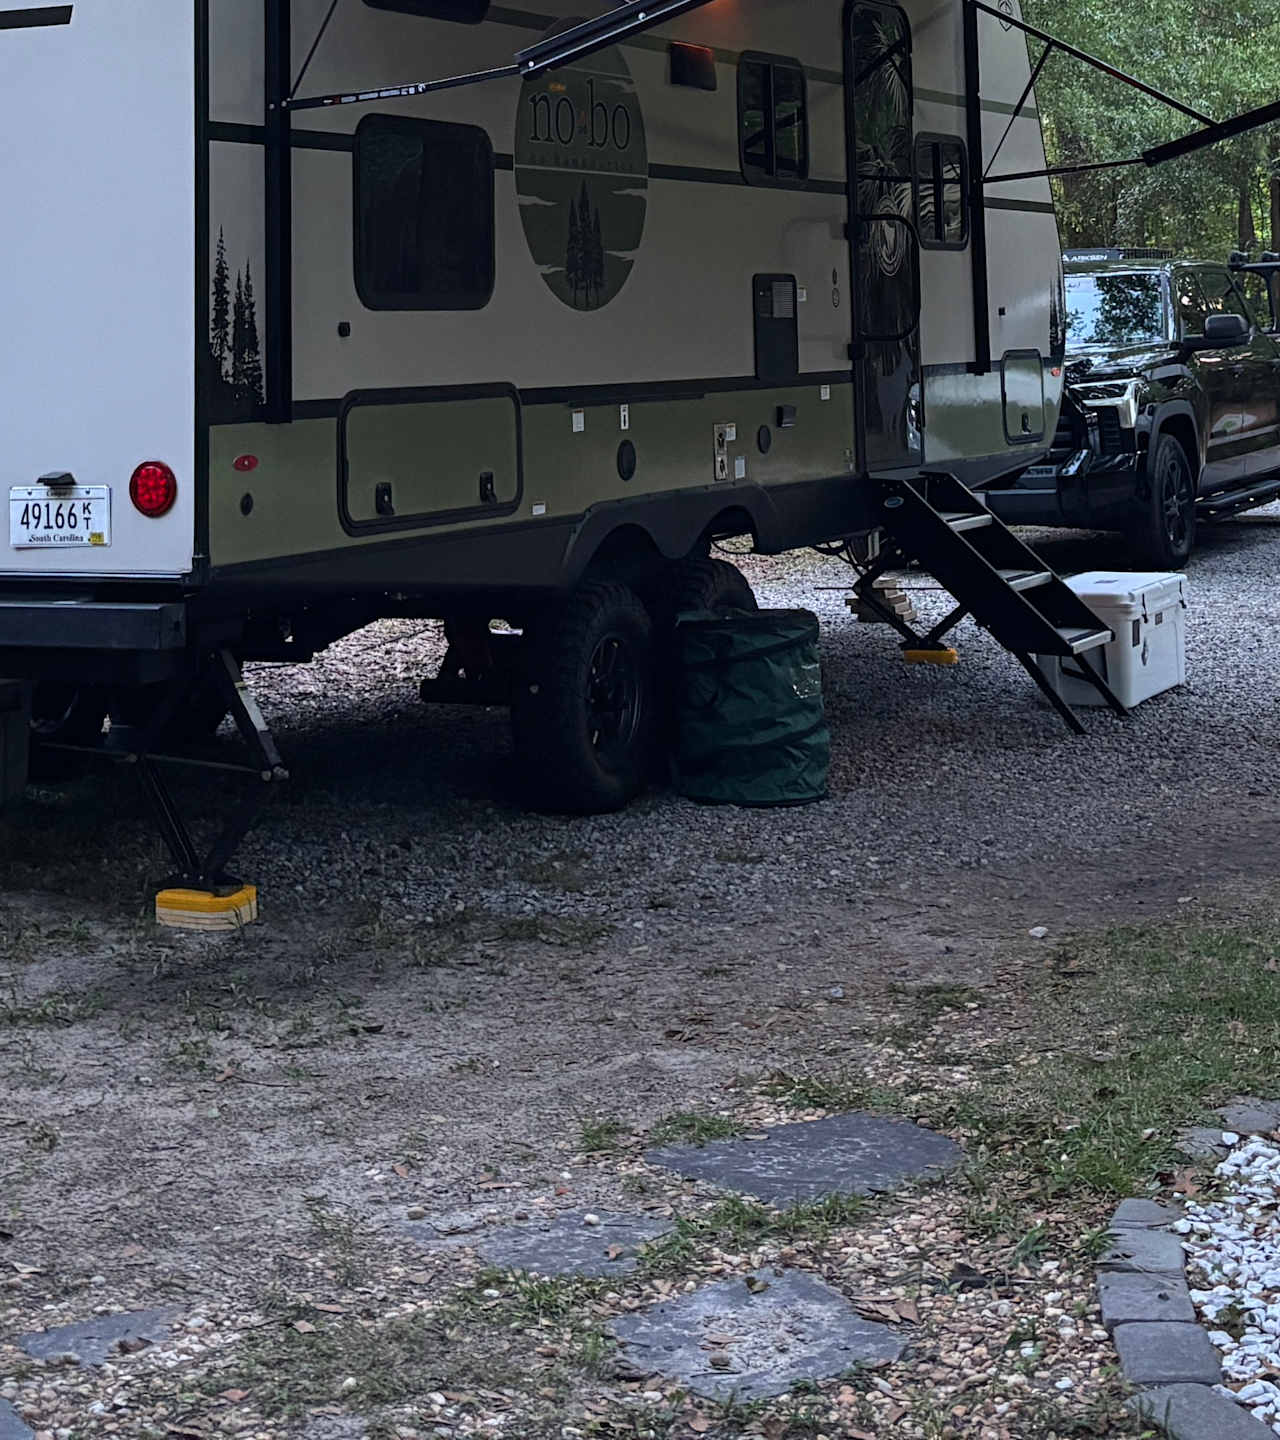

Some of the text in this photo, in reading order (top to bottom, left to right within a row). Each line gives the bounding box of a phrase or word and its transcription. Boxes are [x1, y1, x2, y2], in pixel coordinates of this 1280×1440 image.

[20, 502, 78, 530] 49166
[30, 534, 52, 543] South
[53, 533, 84, 543] Carolina
